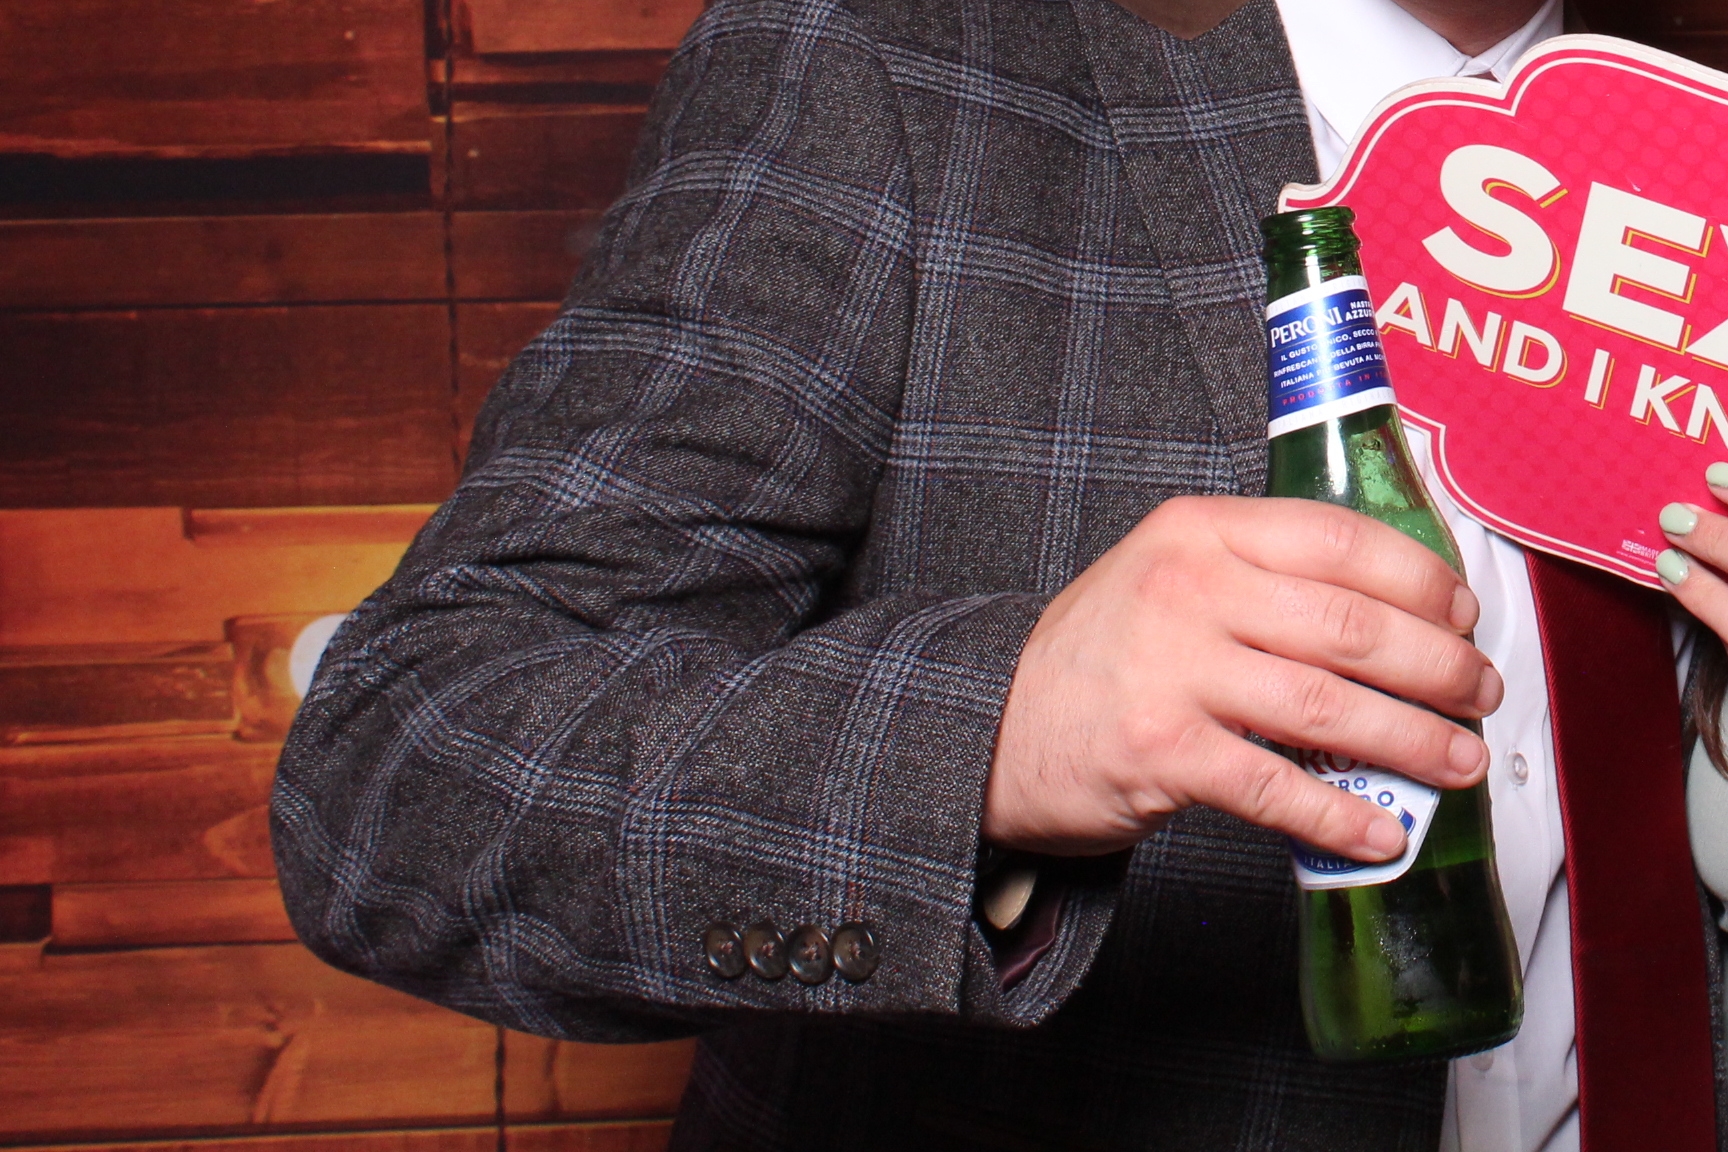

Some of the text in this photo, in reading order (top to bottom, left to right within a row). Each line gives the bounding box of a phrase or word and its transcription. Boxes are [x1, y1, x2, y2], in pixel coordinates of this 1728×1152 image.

[1345, 308, 1374, 322] AZZUR
[1350, 300, 1372, 310] NASTR
[1270, 306, 1343, 348] PERONI
[1281, 354, 1288, 362] IL
[1288, 344, 1318, 359] GUSTO
[1321, 334, 1352, 347] NICO,
[1353, 328, 1375, 338] SECCO
[1375, 281, 1567, 387] AND
[1584, 348, 1614, 408] I
[1273, 354, 1327, 378] RINFRESCANT
[1330, 346, 1356, 359] DELLA
[1280, 372, 1315, 389] ITALIANA
[1333, 357, 1364, 371] BEVUTA
[1365, 354, 1373, 362] AL
